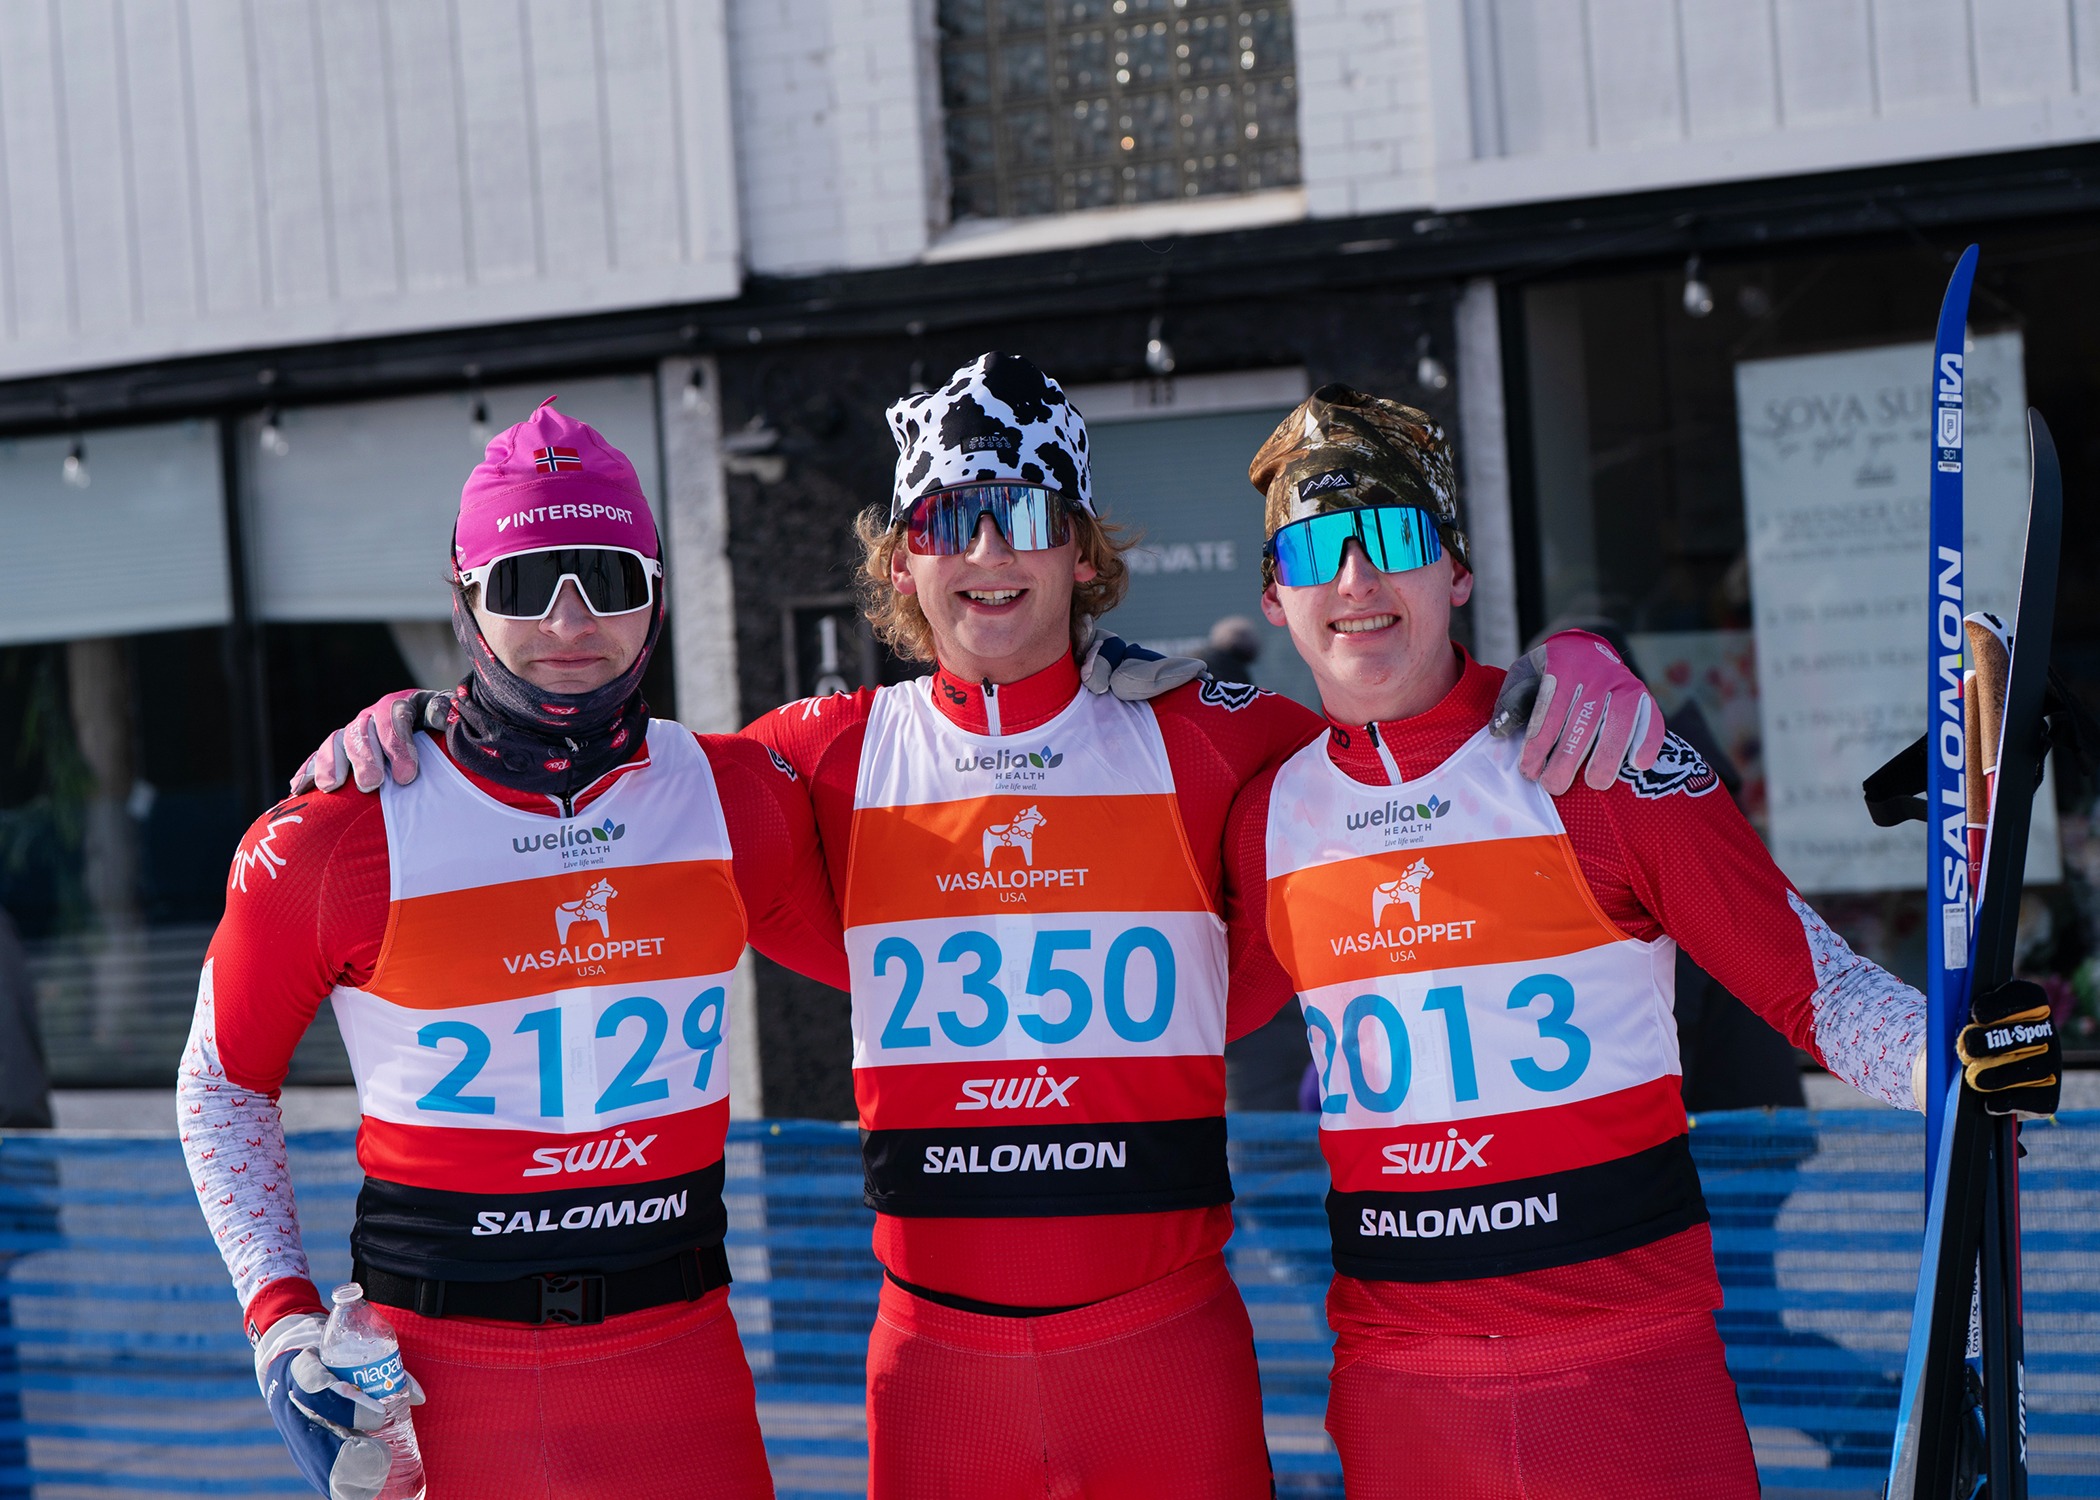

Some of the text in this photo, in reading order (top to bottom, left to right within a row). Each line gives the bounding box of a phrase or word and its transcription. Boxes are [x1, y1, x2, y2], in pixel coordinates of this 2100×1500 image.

[513, 503, 633, 528] INTERSPORT
[1563, 700, 1596, 755] HESTRA
[1938, 546, 1967, 904] SALOMON
[955, 749, 1028, 772] welia
[995, 772, 1045, 780] HEALTH
[1346, 800, 1417, 831] welia
[1384, 823, 1432, 836] HEALTH
[561, 845, 611, 859] HEALTH
[935, 868, 1089, 893] VASALOPPET
[999, 892, 1027, 903] USA
[1330, 920, 1476, 957] VASALOPPET
[502, 936, 665, 976] VASALOPPET
[577, 964, 606, 977] USA
[1389, 949, 1417, 963] USA
[873, 926, 1177, 1050] 2350
[415, 986, 726, 1117] 2129
[1304, 973, 1592, 1115] 2013
[923, 1141, 1126, 1174] SALOMON
[471, 1189, 688, 1236] SALOMON
[1359, 1192, 1558, 1238] SALOMON
[353, 1355, 403, 1390] niaga
